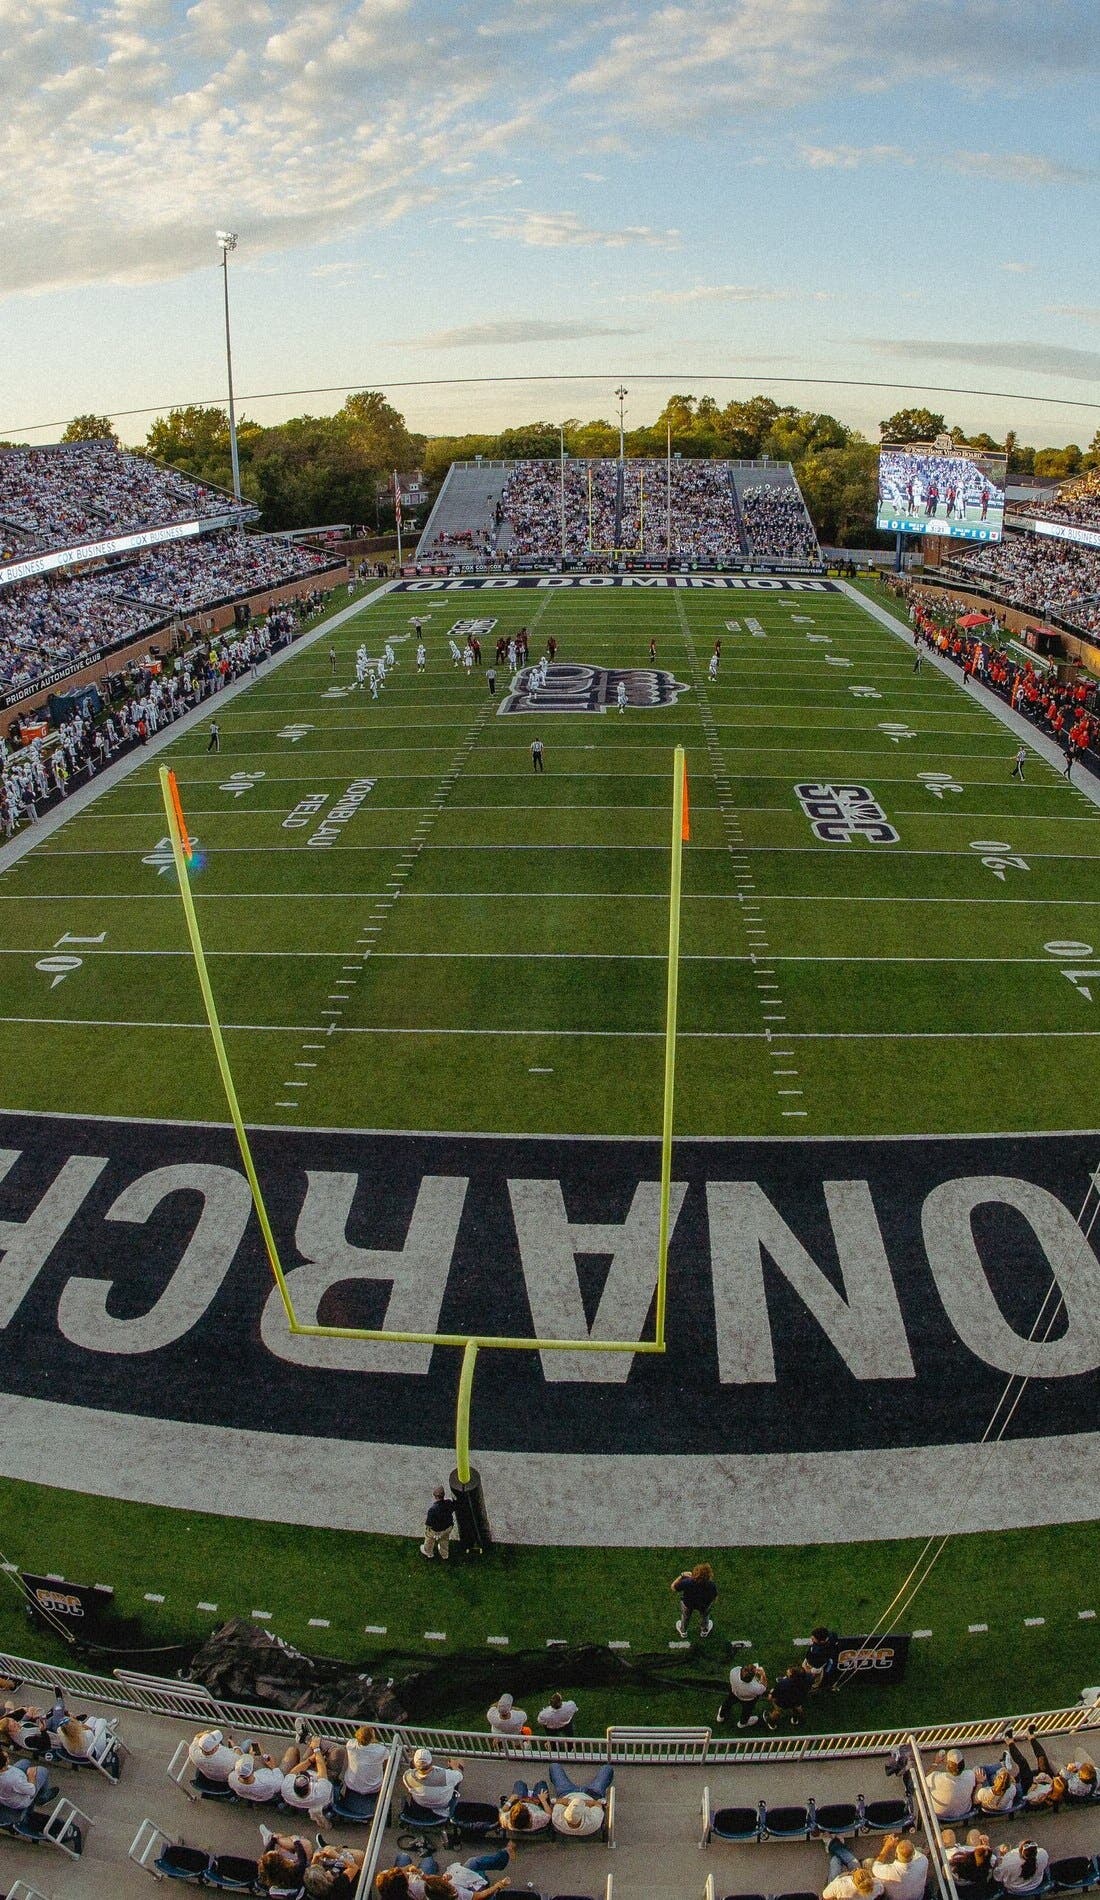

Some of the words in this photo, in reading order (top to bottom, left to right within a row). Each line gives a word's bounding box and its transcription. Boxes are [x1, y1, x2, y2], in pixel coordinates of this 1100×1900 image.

[130, 534, 149, 546] COX
[150, 526, 184, 541] BUSINESS
[57, 551, 74, 565] COX
[77, 541, 116, 560] BUSINESS
[7, 559, 45, 580] BUSINESS
[406, 579, 519, 591] OLD
[537, 577, 827, 591] DOMINION
[5, 682, 40, 706] PRIORITY
[40, 662, 84, 689] AUTOMOTIVE
[85, 652, 101, 666] CLUB
[218, 771, 266, 791] 30
[916, 772, 964, 793] 30
[281, 793, 330, 828] FIELD
[306, 778, 378, 846] KORNBLAU
[969, 840, 1031, 871] 20
[35, 931, 107, 972] 10
